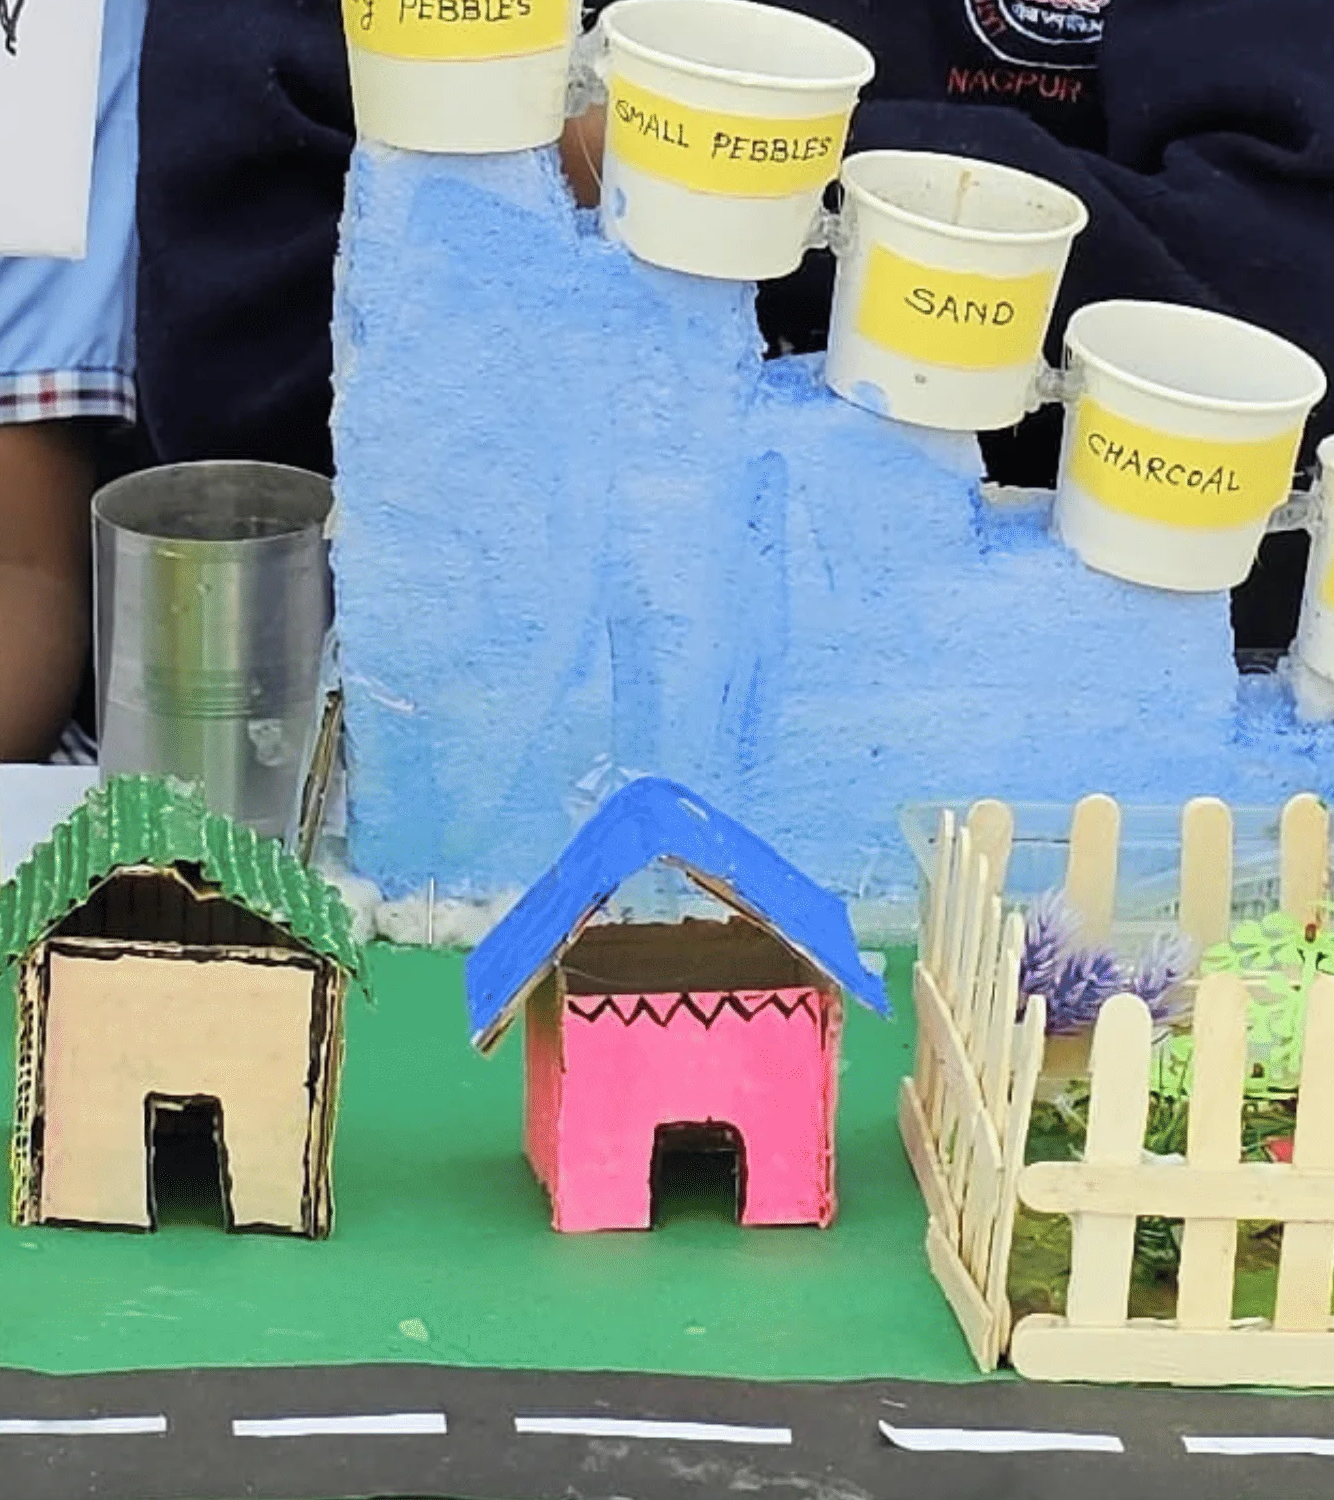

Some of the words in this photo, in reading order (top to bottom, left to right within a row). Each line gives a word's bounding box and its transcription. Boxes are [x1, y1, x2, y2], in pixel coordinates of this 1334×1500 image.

[946, 66, 1083, 103] NAGPUR
[615, 99, 690, 148] SMALL
[711, 131, 833, 163] PEBBLES
[904, 286, 1015, 327] SAND
[1087, 432, 1240, 495] CHARCOAL
